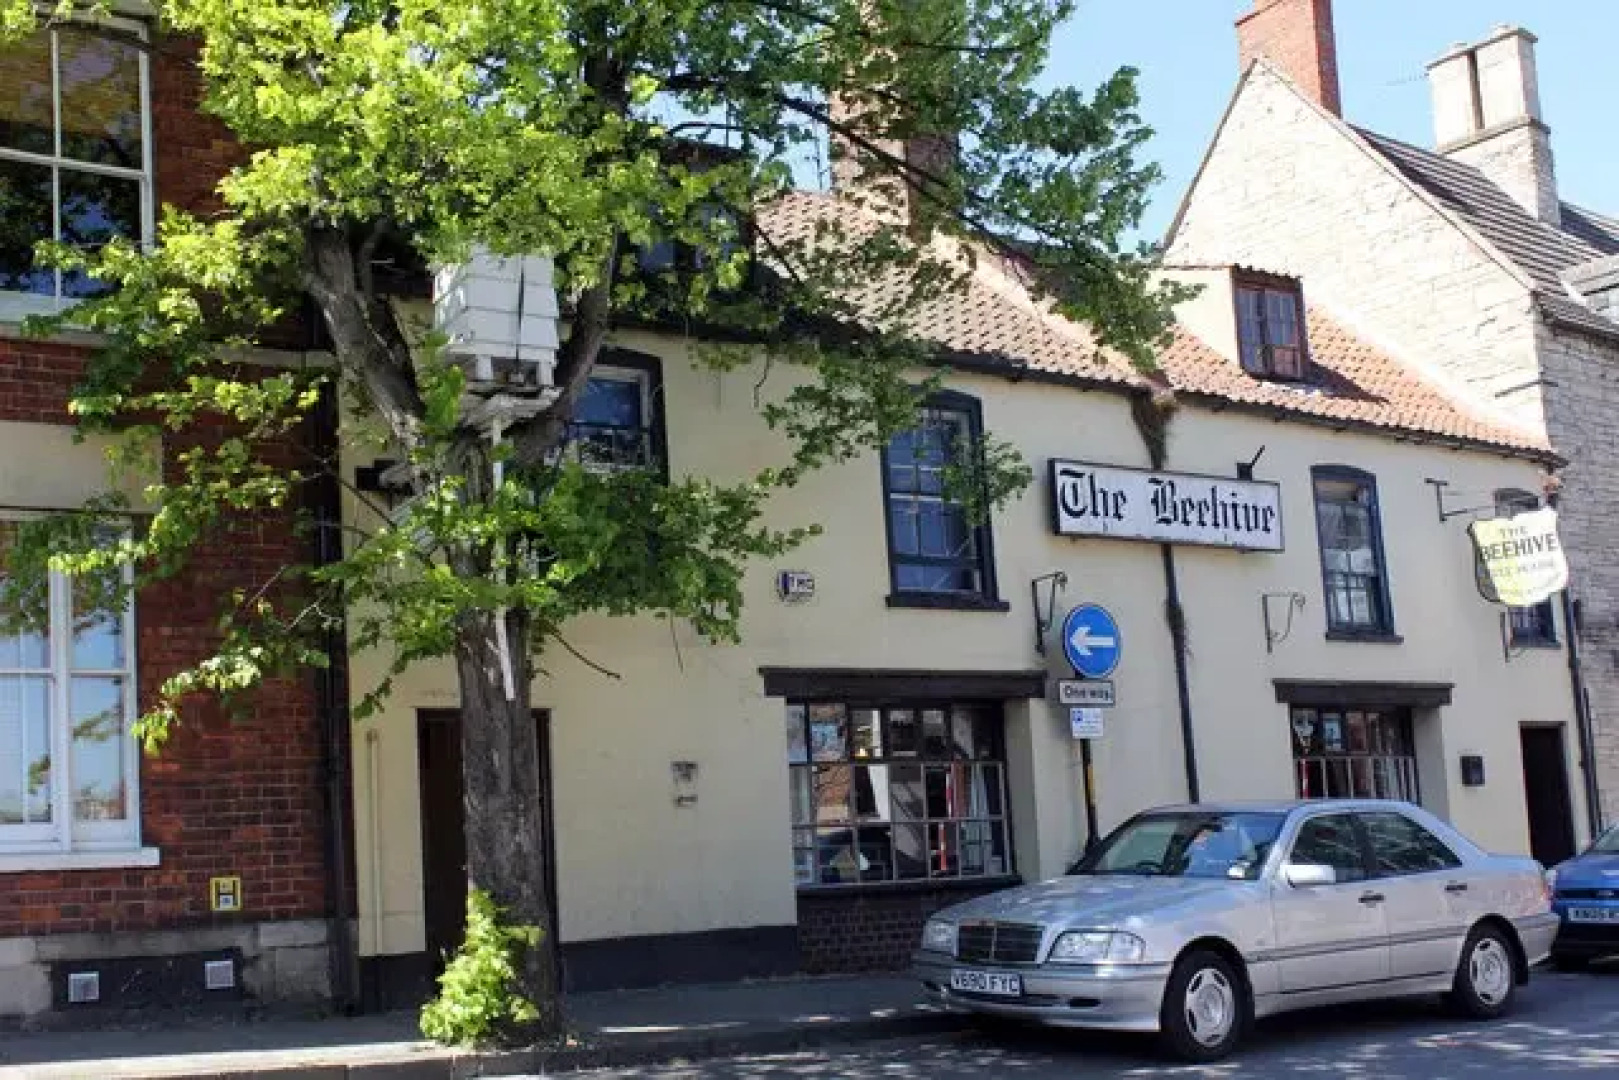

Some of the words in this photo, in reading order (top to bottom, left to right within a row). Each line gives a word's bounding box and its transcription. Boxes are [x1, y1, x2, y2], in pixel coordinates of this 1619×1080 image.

[1059, 468, 1127, 521] The
[1148, 477, 1276, 535] Beehive
[1481, 532, 1556, 560] BEEHIVE
[1499, 525, 1528, 539] THE
